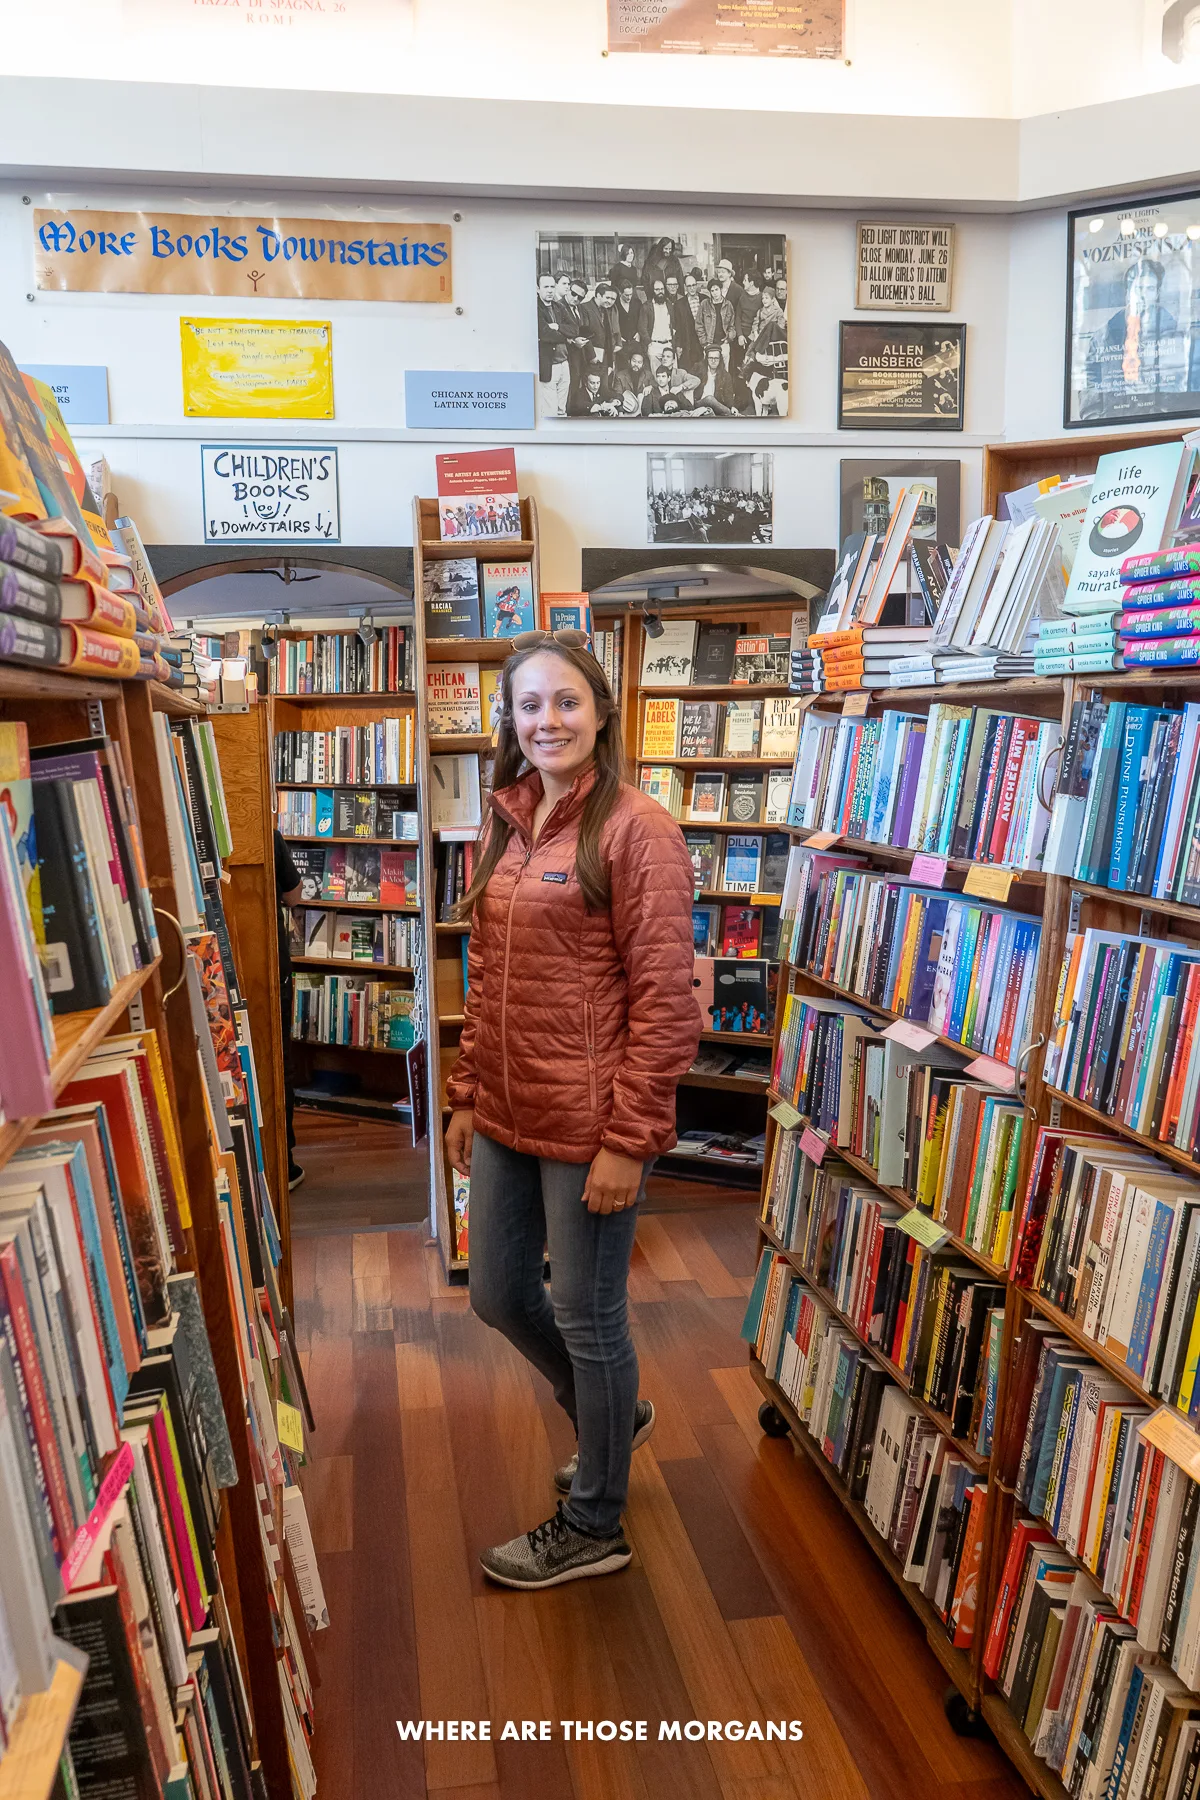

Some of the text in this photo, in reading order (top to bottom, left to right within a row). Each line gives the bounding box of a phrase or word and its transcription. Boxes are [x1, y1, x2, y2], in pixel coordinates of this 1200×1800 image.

[619, 25, 648, 35] BOCCHI
[1134, 208, 1159, 217] LIGHTS
[150, 223, 249, 262] Books
[861, 229, 948, 246] RED LIGHT DISTRICT WILL
[861, 248, 882, 263] CLOSE
[919, 249, 935, 264] JUNE
[939, 251, 948, 264] 26
[861, 266, 947, 283] TO ALLOW GIRLS TO ATTEND
[870, 285, 935, 301] POLICEMEN'S BALL
[883, 345, 923, 355] ALLEN
[859, 356, 923, 367] GINSBERG
[431, 391, 509, 399] CHICANX ROOTS
[434, 401, 507, 409] LATINX VOICES
[213, 451, 332, 482] CHILDREN'S
[1118, 465, 1142, 481] life
[232, 483, 310, 501] BOOKS
[1091, 483, 1159, 504] ceremony
[221, 520, 311, 535] DOWNSTAIRS
[487, 566, 528, 574] LATINX
[917, 567, 925, 582] CODE
[1088, 568, 1121, 579] sayaka
[1134, 566, 1160, 578] SPIDER KING
[1173, 562, 1189, 571] JAMES
[1137, 594, 1164, 605] SPIDER KING
[1177, 590, 1193, 599] JAMES
[1049, 626, 1068, 634] ceremony
[1135, 621, 1163, 633] SPIDER KING
[1177, 619, 1193, 629] JAMES
[737, 641, 766, 653] sittin' in
[1181, 649, 1198, 659] JAMES
[1139, 650, 1167, 661] SPIDER KING
[648, 701, 674, 710] MAJOR
[646, 711, 676, 723] LABELS
[683, 725, 700, 735] PLAY
[994, 723, 1003, 753] ZAKES
[682, 736, 707, 745] TILL WE
[1060, 719, 1078, 778] THE MAIAS
[682, 748, 695, 756] DIE
[999, 729, 1025, 821] ANCHEE MIN
[1111, 735, 1135, 862] DIVINE PUNISHMENT
[728, 838, 759, 847] DILLA
[726, 883, 755, 892] TIME
[1007, 947, 1018, 988] MURAKAMI
[1031, 1150, 1039, 1168] Death
[1020, 1199, 1029, 1219] Effect
[1102, 1184, 1116, 1230] FLOWERS
[1105, 1187, 1121, 1243] DON'T SEND
[1151, 1208, 1162, 1232] WOLE
[868, 1212, 880, 1256] SOMERSAULT
[1067, 1229, 1075, 1253] MINER
[1144, 1233, 1157, 1269] SOYINKA
[1086, 1269, 1100, 1313] SOLARES
[934, 1309, 948, 1362] CONSTELLATIONS
[983, 1343, 999, 1430] The Dragonfly Sea
[1025, 1387, 1040, 1431] WELCOME
[1120, 1422, 1126, 1434] MY
[1018, 1439, 1031, 1472] LAGOS
[1116, 1450, 1121, 1459] AS
[1110, 1459, 1121, 1492] EMPEROR
[1106, 1508, 1113, 1517] SU
[1101, 1517, 1112, 1540] TONG
[1016, 1644, 1028, 1672] Distance
[1131, 1688, 1161, 1785] THE INVISIBLE VALLEY
[1182, 1762, 1196, 1794] BIRD TALK
